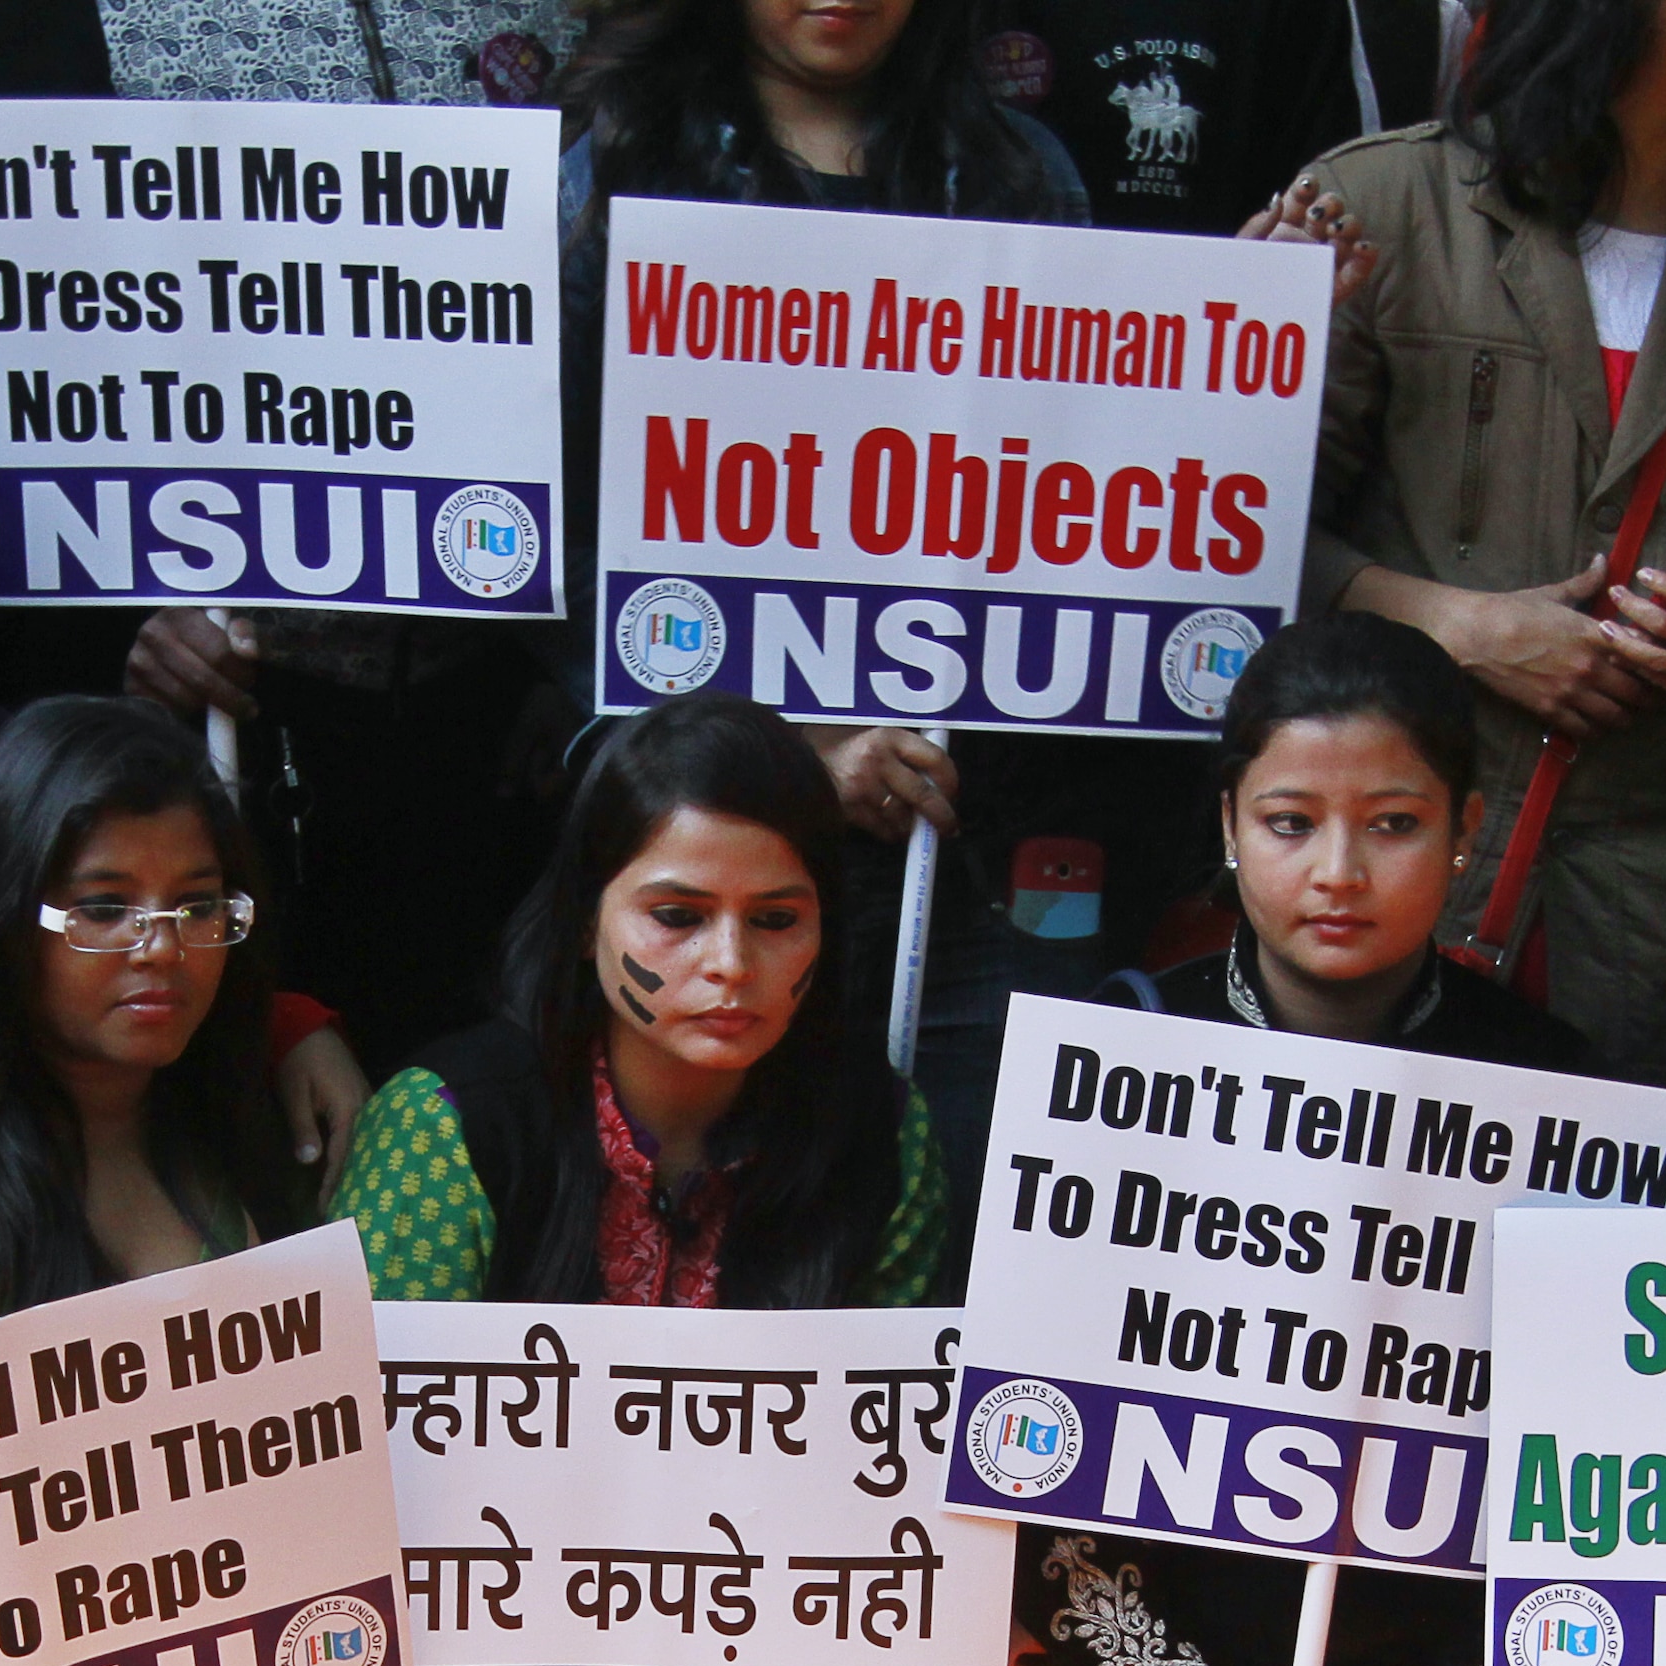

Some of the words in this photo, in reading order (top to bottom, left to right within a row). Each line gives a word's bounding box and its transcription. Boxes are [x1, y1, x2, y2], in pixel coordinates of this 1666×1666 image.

[1133, 39, 1178, 56] POLO
[93, 145, 221, 220] Tell
[241, 147, 341, 224] Me
[362, 151, 509, 229] How
[199, 260, 324, 335] Tell
[341, 264, 532, 345] Them
[627, 262, 849, 367] Women
[862, 279, 963, 375] Are
[979, 286, 1185, 389] Human
[1204, 302, 1305, 398] Too
[8, 371, 127, 442] Not
[141, 371, 224, 443] To
[244, 372, 413, 455] Rape
[438, 487, 503, 526] STUDENTS'
[504, 495, 535, 535] UNION
[643, 416, 822, 549] Not
[850, 428, 1267, 575] Objects
[22, 480, 419, 599] NSUI
[435, 528, 472, 589] NATIONAL
[501, 560, 532, 591] INDIA
[523, 541, 536, 559] OF
[752, 593, 1149, 721] NSUI
[1048, 1044, 1243, 1145] Don't
[1262, 1075, 1396, 1168] Tell
[1406, 1098, 1512, 1184] Me
[1011, 1154, 1093, 1238] To
[1110, 1170, 1328, 1274] Dress
[1350, 1205, 1476, 1294] Tell
[30, 1338, 147, 1425] Me
[164, 1291, 321, 1390] How
[1118, 1288, 1246, 1377] Not
[1265, 1308, 1347, 1391] To
[1361, 1323, 1491, 1417] Rap
[609, 1365, 817, 1455] नजर
[977, 1382, 1053, 1417] STUDENTS'
[1050, 1393, 1079, 1436] UNION
[151, 1395, 362, 1501] Them
[969, 1417, 1003, 1486] NATIONAL
[1034, 1461, 1070, 1492] INDIA
[1062, 1442, 1079, 1462] OF
[56, 1539, 246, 1641] Rape
[280, 1598, 346, 1647] STUDENTS'
[346, 1599, 381, 1632] UNION
[370, 1632, 383, 1650] OF
[561, 1513, 763, 1661] कपड़े
[788, 1517, 943, 1648] नही
[1513, 1586, 1586, 1625] STUDENTS'
[1586, 1594, 1619, 1635] UNION
[1604, 1640, 1620, 1659] OF
